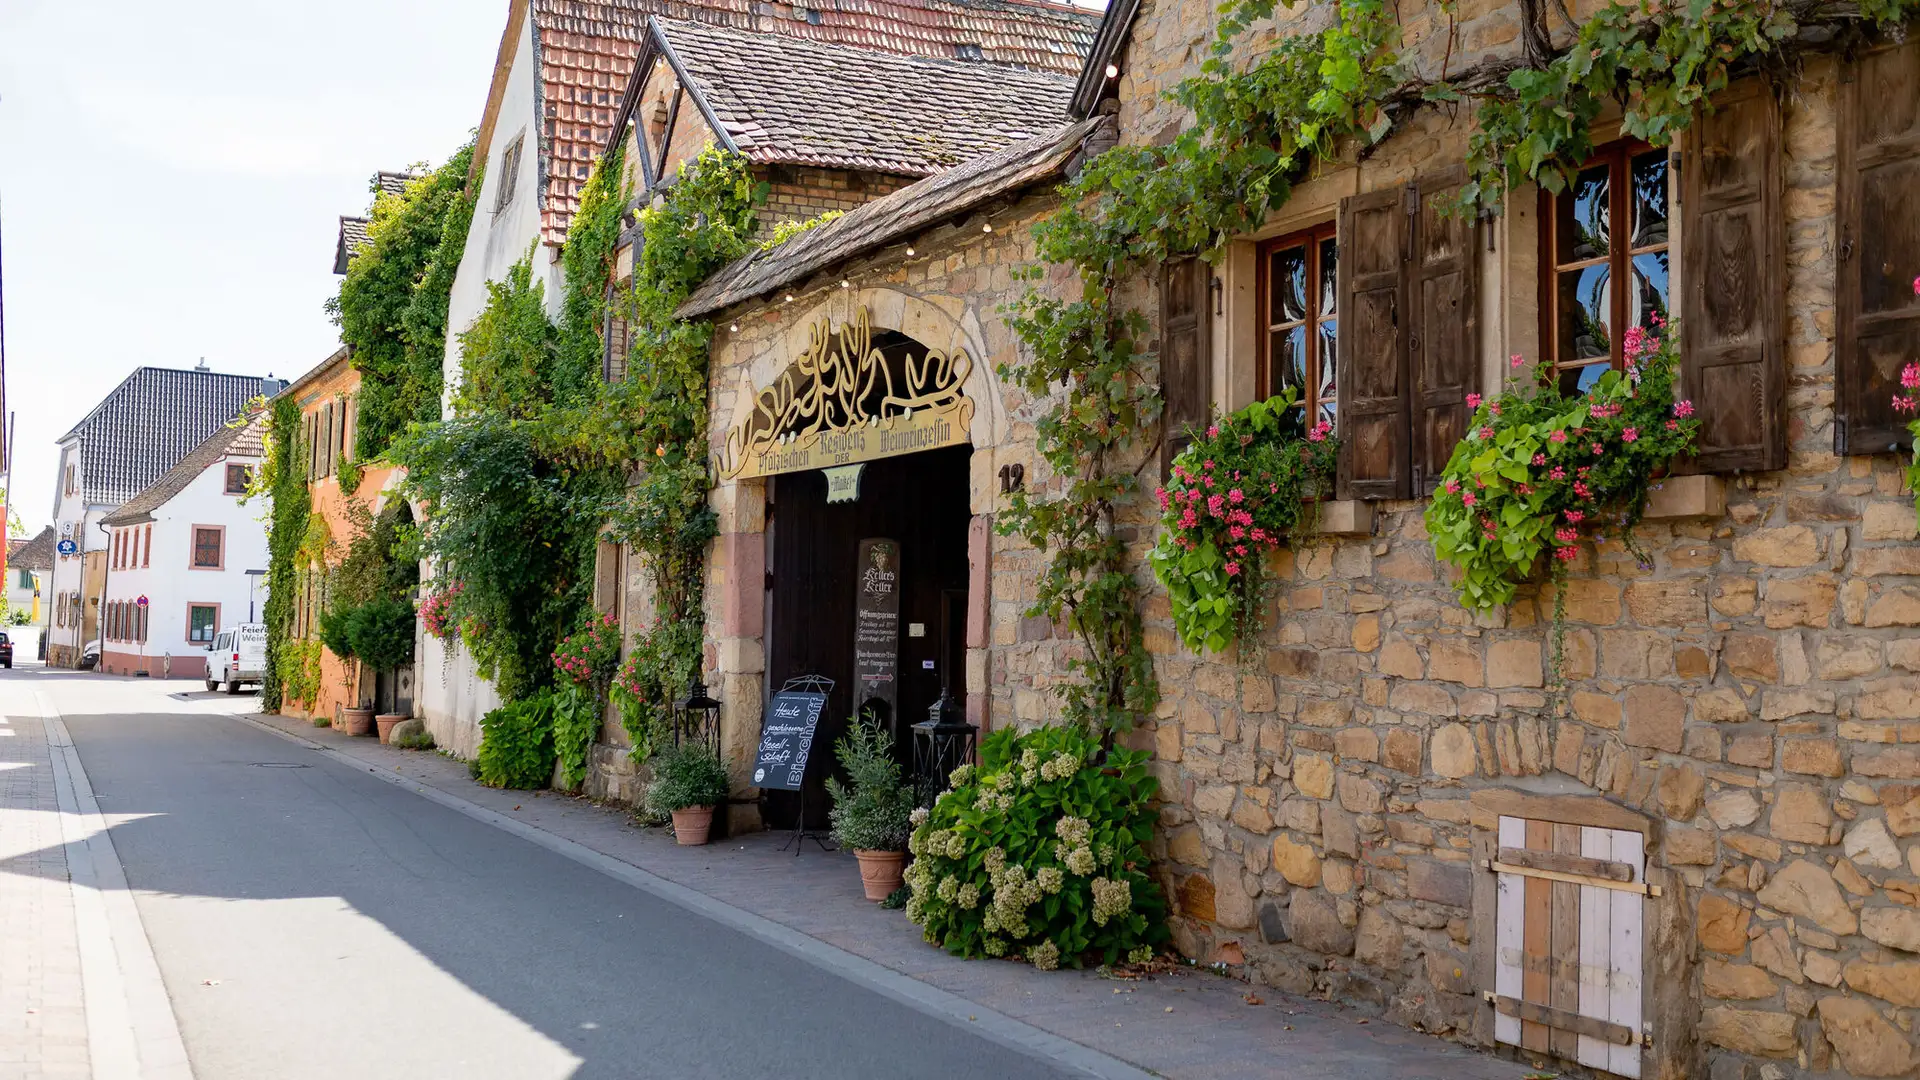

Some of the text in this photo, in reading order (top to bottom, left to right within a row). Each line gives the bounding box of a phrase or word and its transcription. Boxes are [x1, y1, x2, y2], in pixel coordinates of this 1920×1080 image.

[820, 430, 865, 456] Residenz
[835, 453, 850, 463] DER
[998, 463, 1024, 494] 12
[864, 580, 892, 593] Keller
[774, 702, 800, 717] Heute
[787, 697, 824, 786] Bischoff
